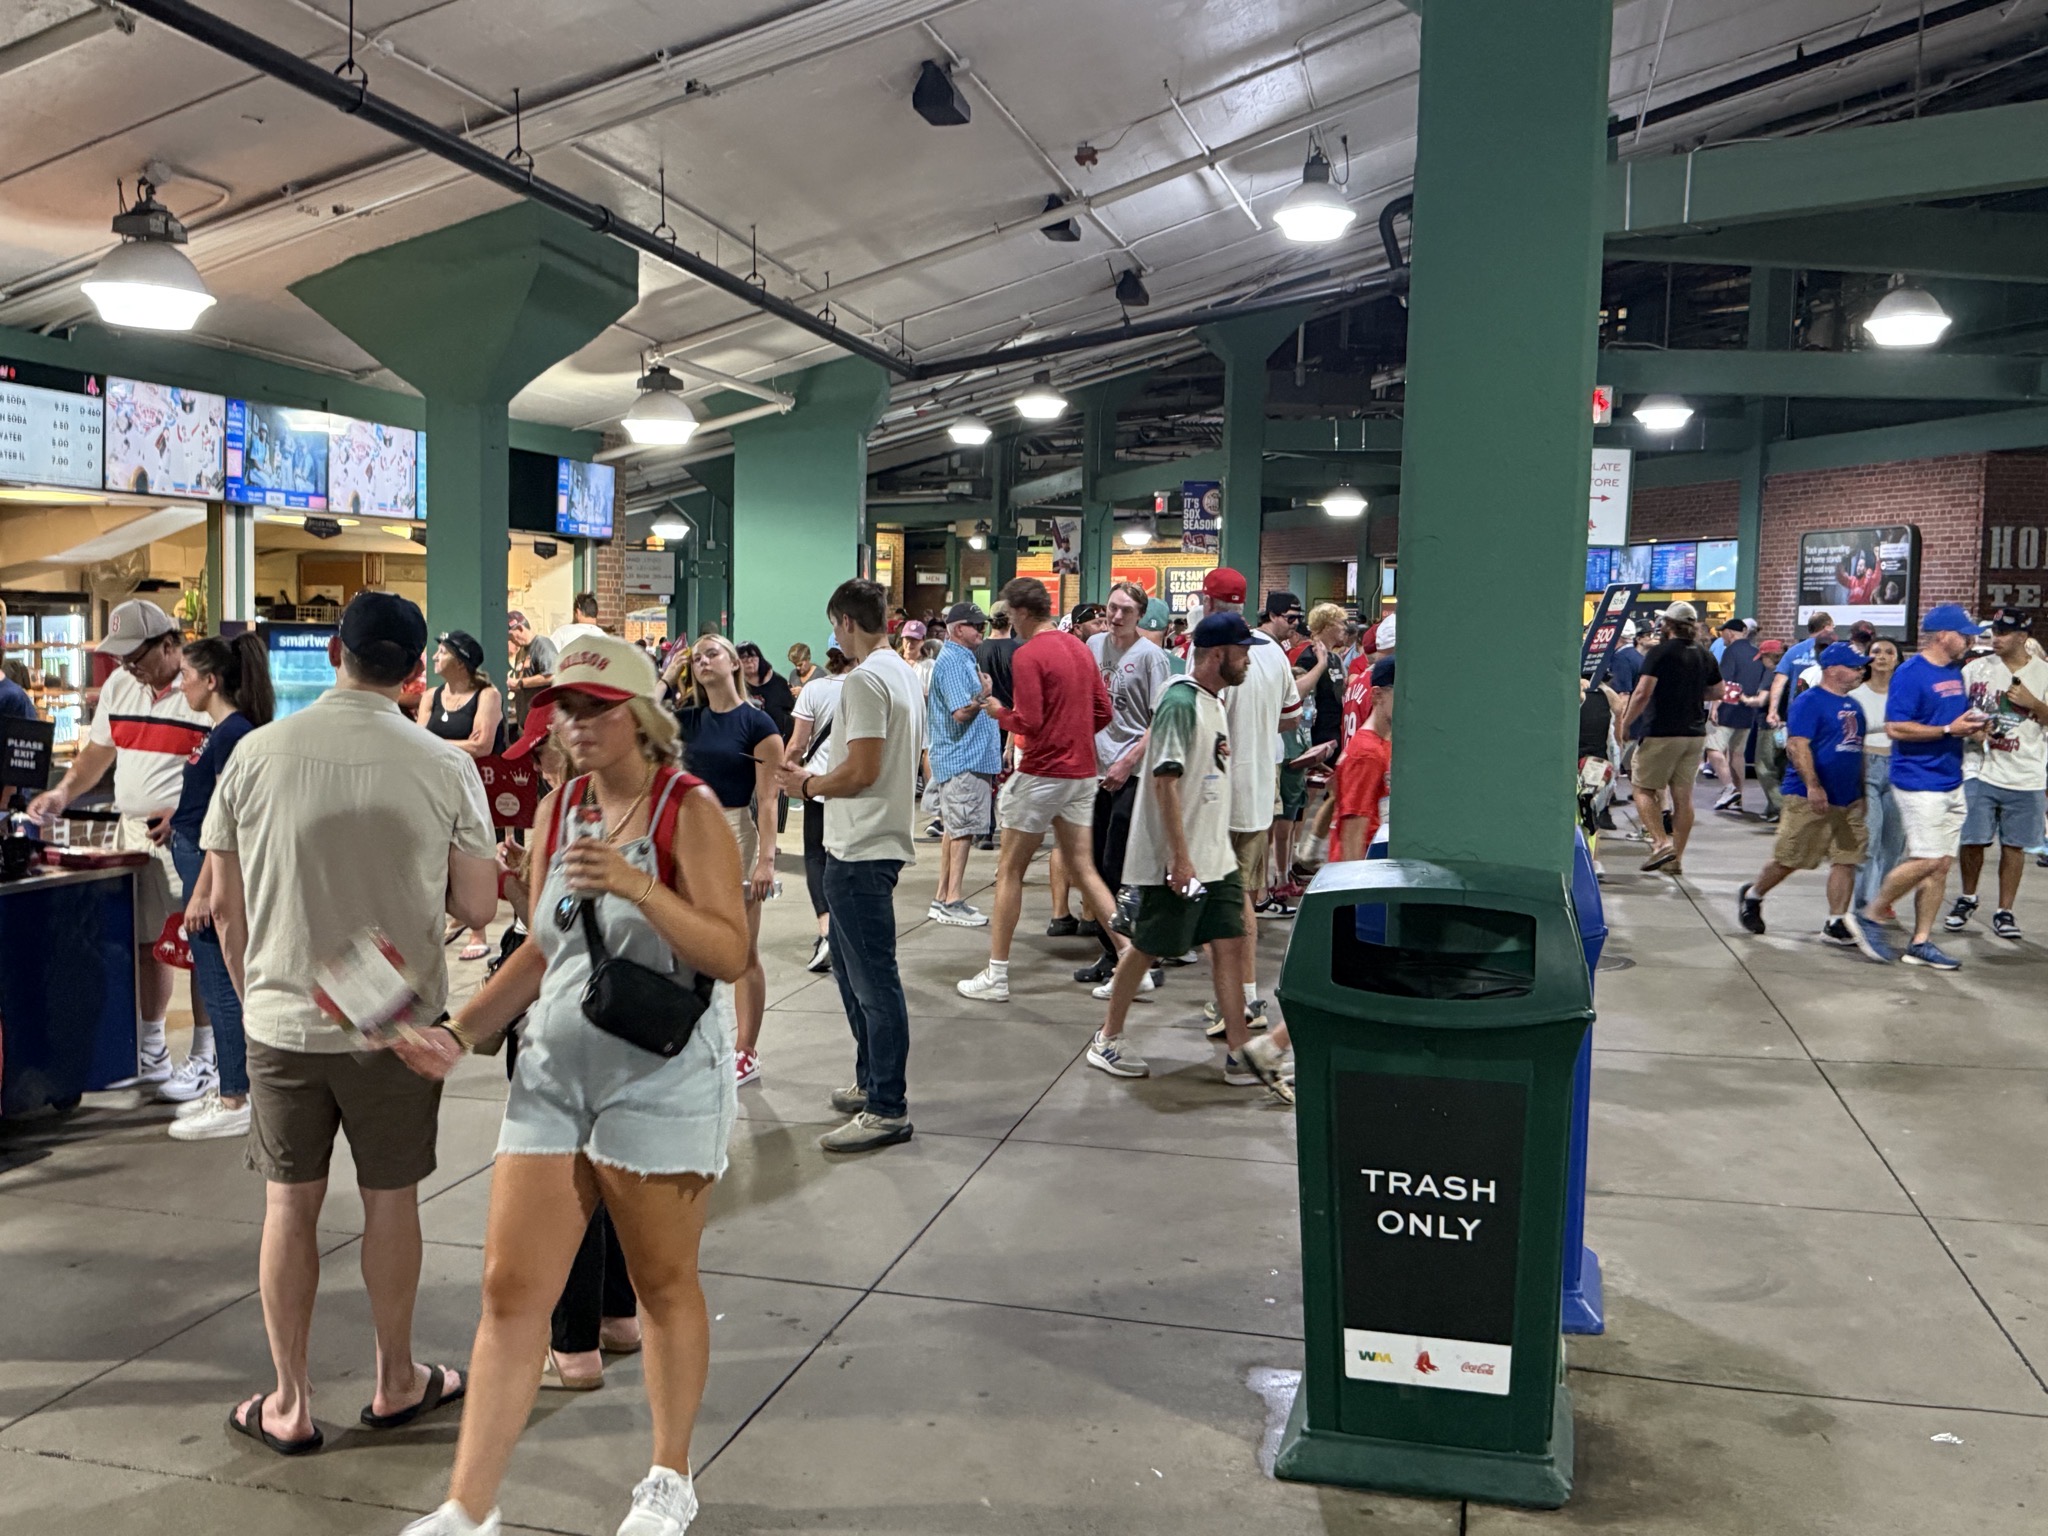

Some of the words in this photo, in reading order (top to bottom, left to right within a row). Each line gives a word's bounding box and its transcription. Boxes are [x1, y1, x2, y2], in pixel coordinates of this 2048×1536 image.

[6, 394, 27, 406] SODA
[7, 414, 27, 425] SODA
[1592, 463, 1621, 472] LATE
[1591, 478, 1620, 487] ORE
[1183, 498, 1200, 509] IT'S
[1183, 509, 1201, 520] SOX
[1183, 520, 1217, 530] SEASON
[1989, 526, 2048, 570] HO
[1170, 570, 1186, 582] IT'S
[1170, 581, 1203, 593] SEASON
[1987, 584, 2048, 608] TE
[112, 614, 121, 633] B
[1150, 619, 1157, 628] B
[279, 634, 331, 648] smartwa
[1593, 627, 1616, 643] 300
[1124, 663, 1135, 674] C
[7, 738, 44, 751] PLEASE
[13, 749, 36, 759] EXIT
[10, 758, 37, 770] HERE
[481, 766, 495, 785] B
[1361, 1168, 1497, 1204] TRASH
[1376, 1209, 1482, 1242] ONLY
